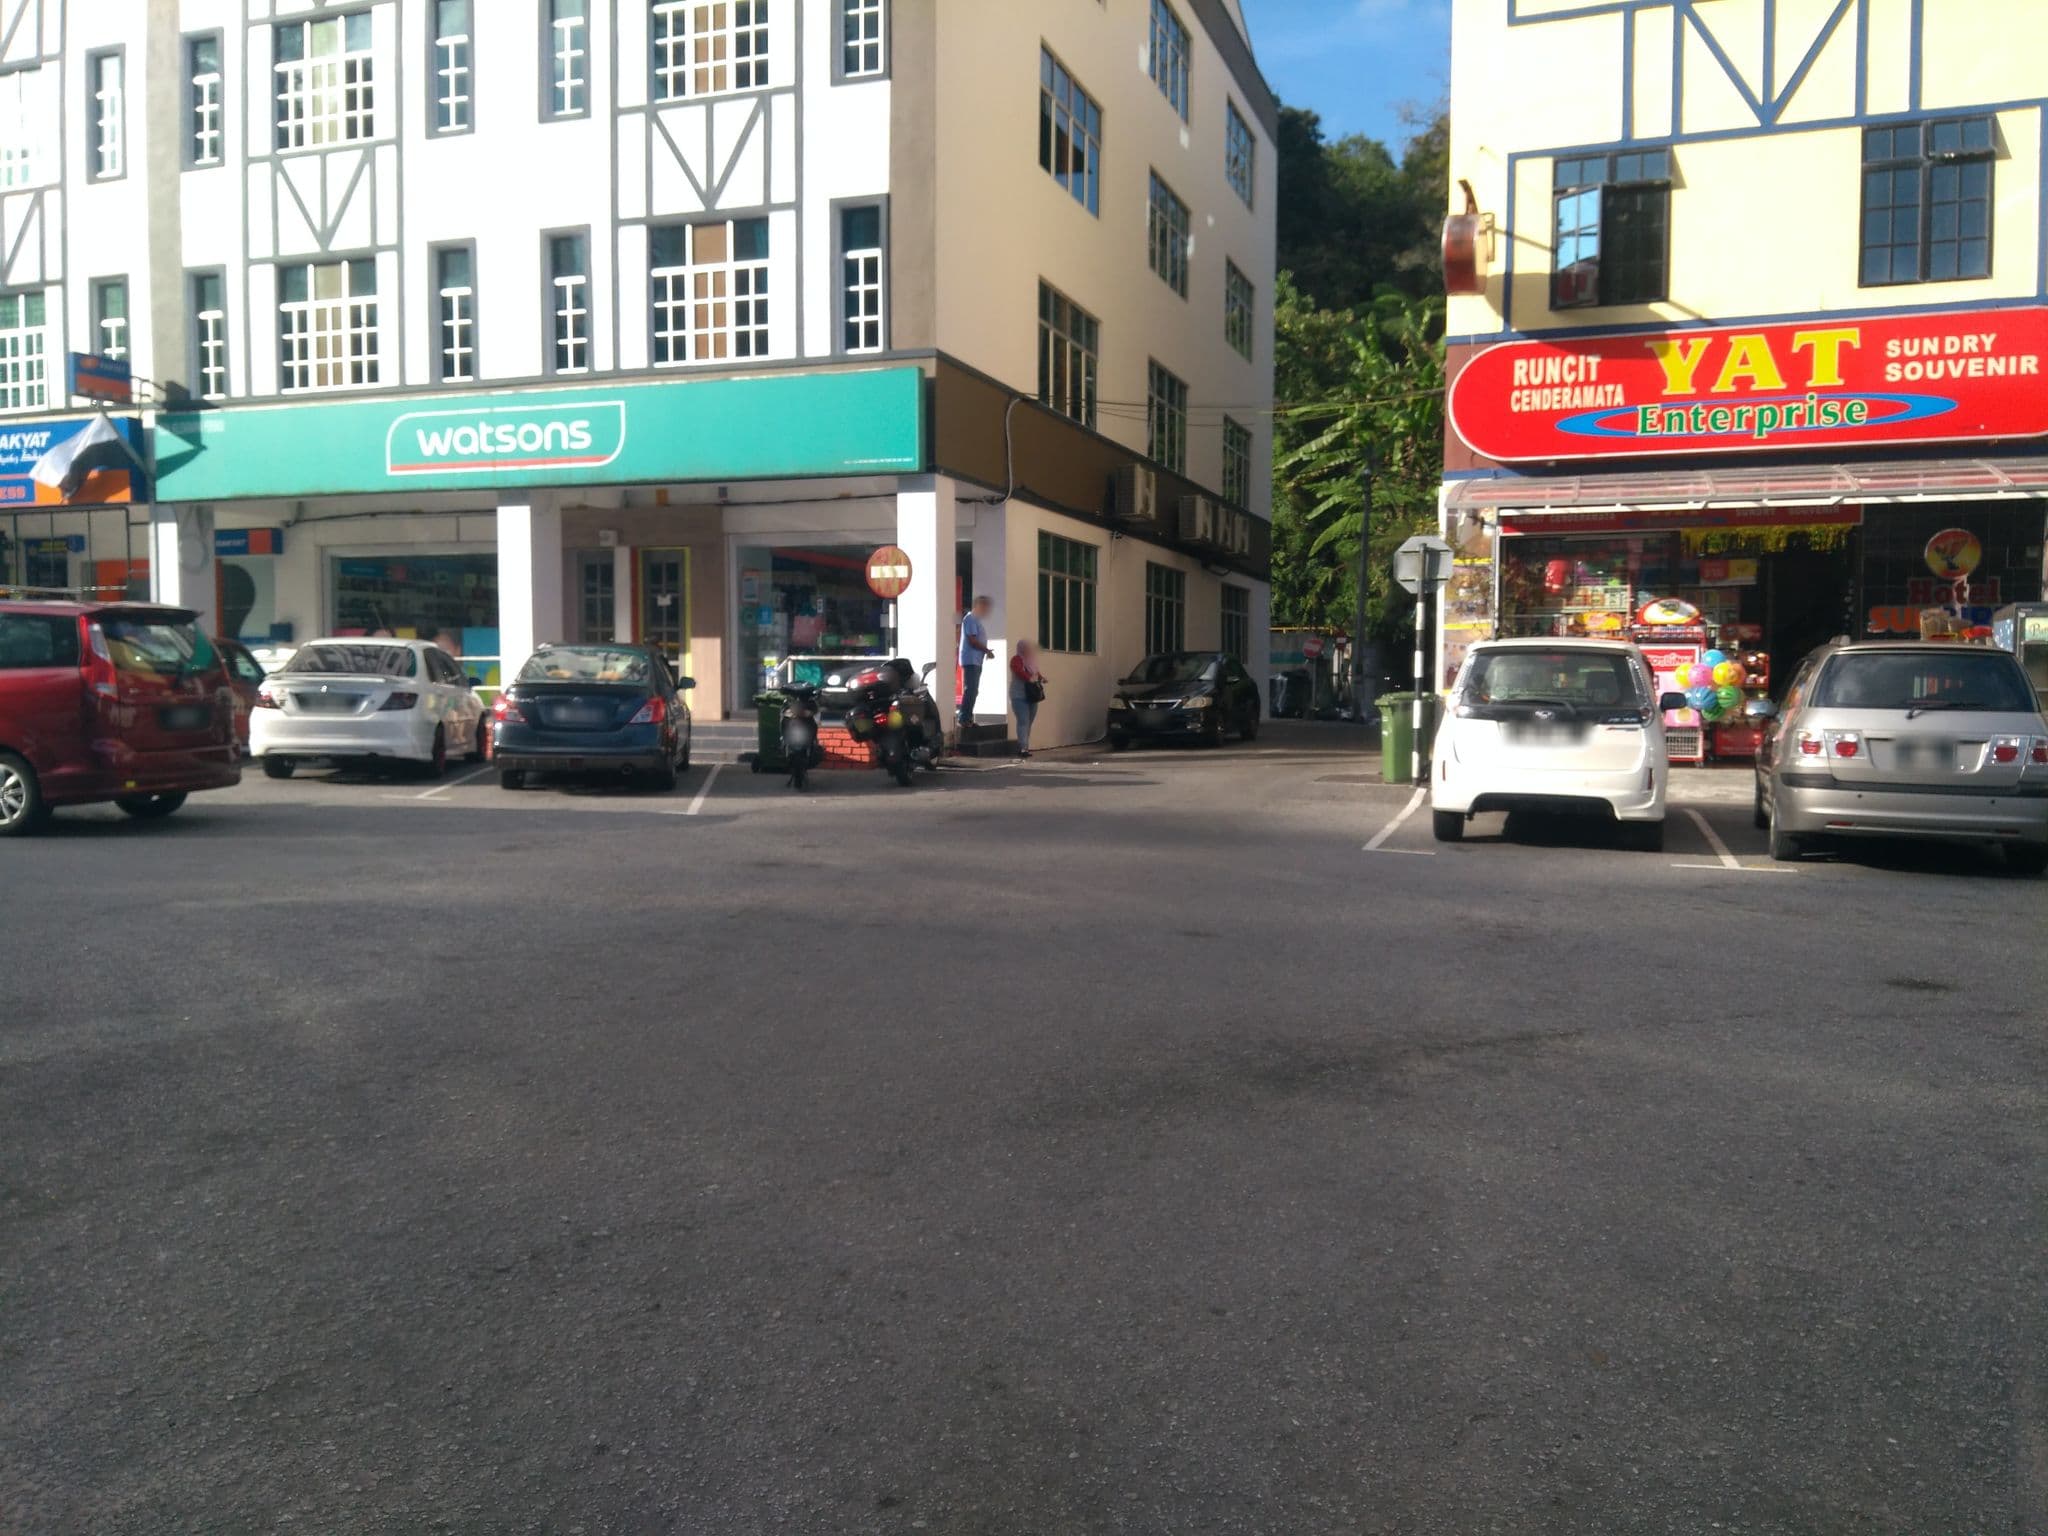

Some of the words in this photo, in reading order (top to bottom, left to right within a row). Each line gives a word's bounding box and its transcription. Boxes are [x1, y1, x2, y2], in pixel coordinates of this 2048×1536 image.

[1644, 327, 1861, 396] YAT
[1885, 332, 1998, 358] SUNDRY
[1513, 354, 1601, 387] RUNCIT
[1884, 354, 2040, 382] SOUVENIR
[1510, 383, 1625, 413] CENDERAMATA
[1636, 392, 1868, 439] Enterprise
[416, 419, 593, 457] watsons
